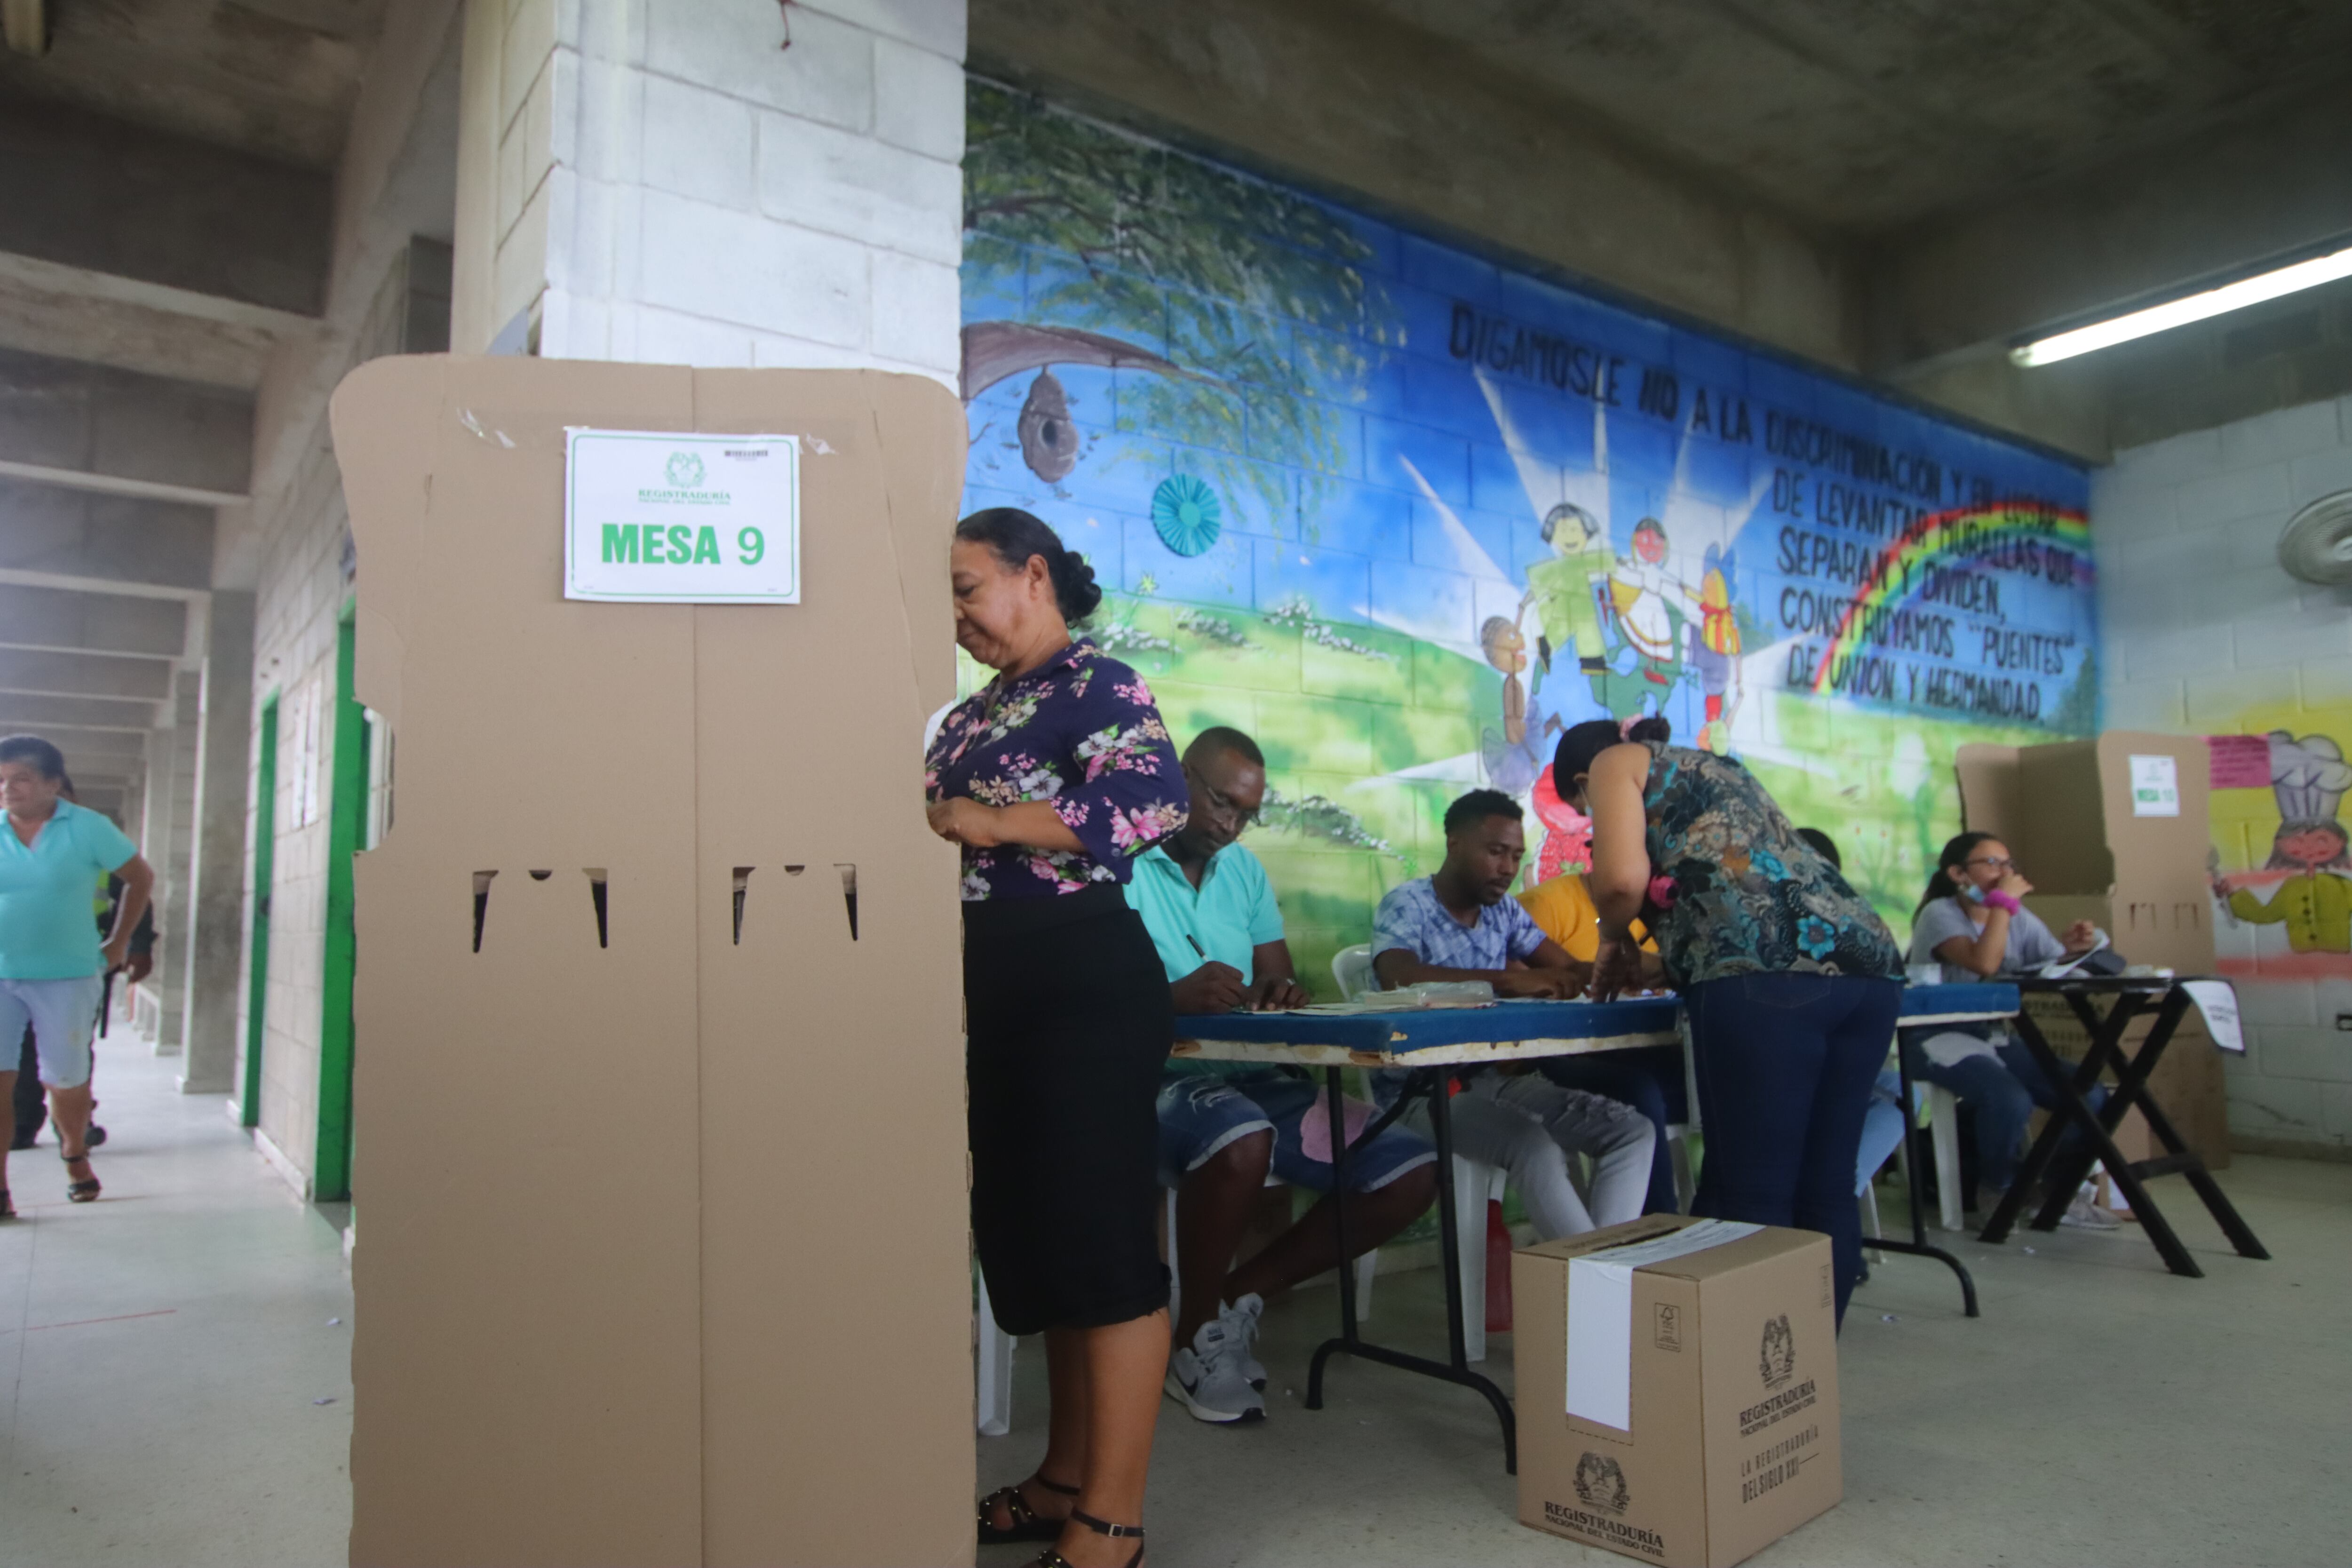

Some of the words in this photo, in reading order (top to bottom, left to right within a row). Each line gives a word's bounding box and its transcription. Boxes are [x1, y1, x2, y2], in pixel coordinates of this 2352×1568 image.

[1449, 302, 1626, 407] DIGAMOSLE
[1638, 365, 1679, 421] NO
[1693, 387, 1711, 434] A
[1720, 396, 1752, 445] LA
[1773, 468, 1805, 517] DE
[1816, 480, 1927, 548] LEVANTAR
[602, 523, 721, 565] MESA
[738, 526, 765, 565] 9
[1777, 525, 1889, 592] SEPARAN
[1899, 557, 1913, 595] Y
[1780, 586, 1955, 659] CONSTRUYAMOS
[1787, 643, 1819, 687] DE
[1829, 652, 1895, 701] UNION
[1907, 662, 1920, 702] Y
[1739, 1376, 1816, 1427] REGISTRADURÍA
[1742, 1480, 1758, 1504] DEL
[1545, 1501, 1664, 1549] REGISTRADURÍA
[1545, 1514, 1585, 1533] NACIONAL
[1606, 1533, 1639, 1550] ESTADO
[1641, 1544, 1665, 1558] CIVIL
